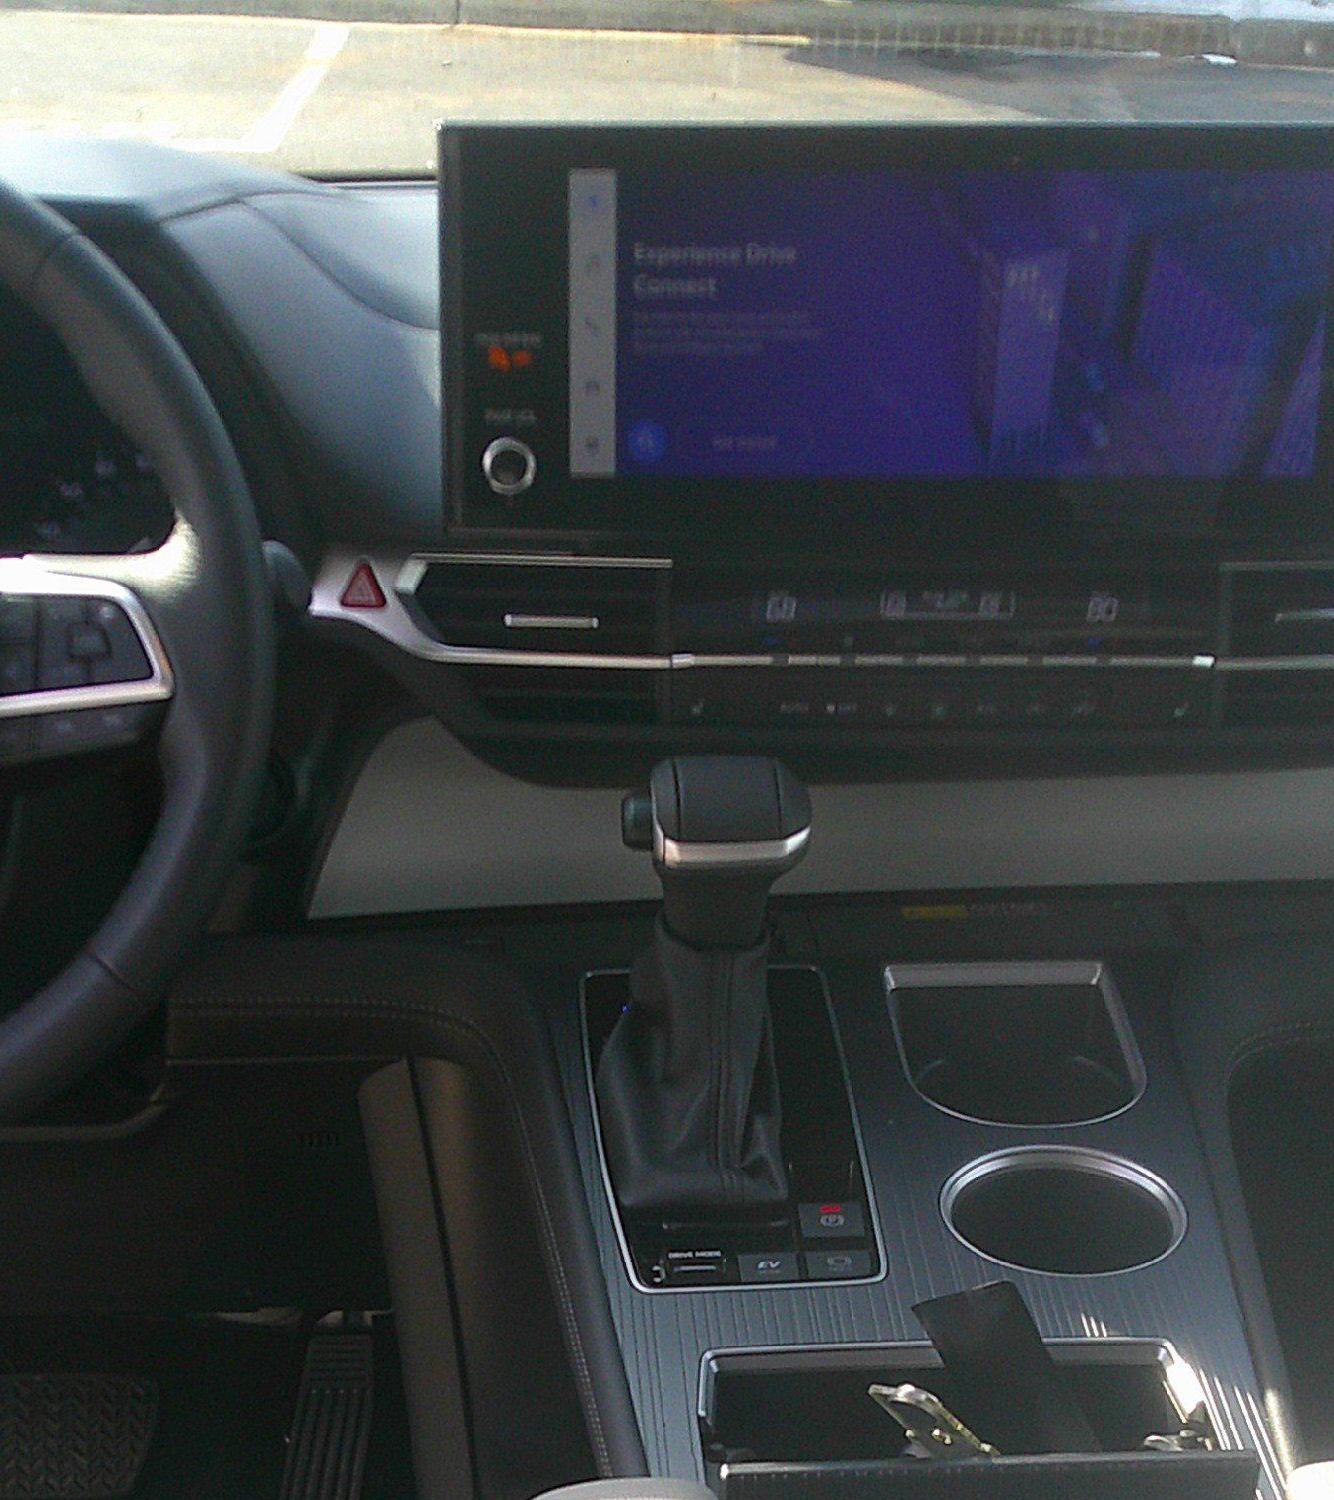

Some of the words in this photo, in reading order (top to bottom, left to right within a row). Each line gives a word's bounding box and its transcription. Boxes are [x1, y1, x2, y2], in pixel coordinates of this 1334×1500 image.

[633, 242, 742, 270] Experience
[745, 241, 797, 266] Drive
[632, 273, 718, 300] Connect
[695, 1249, 722, 1258] MODE
[757, 1260, 781, 1269] EV
